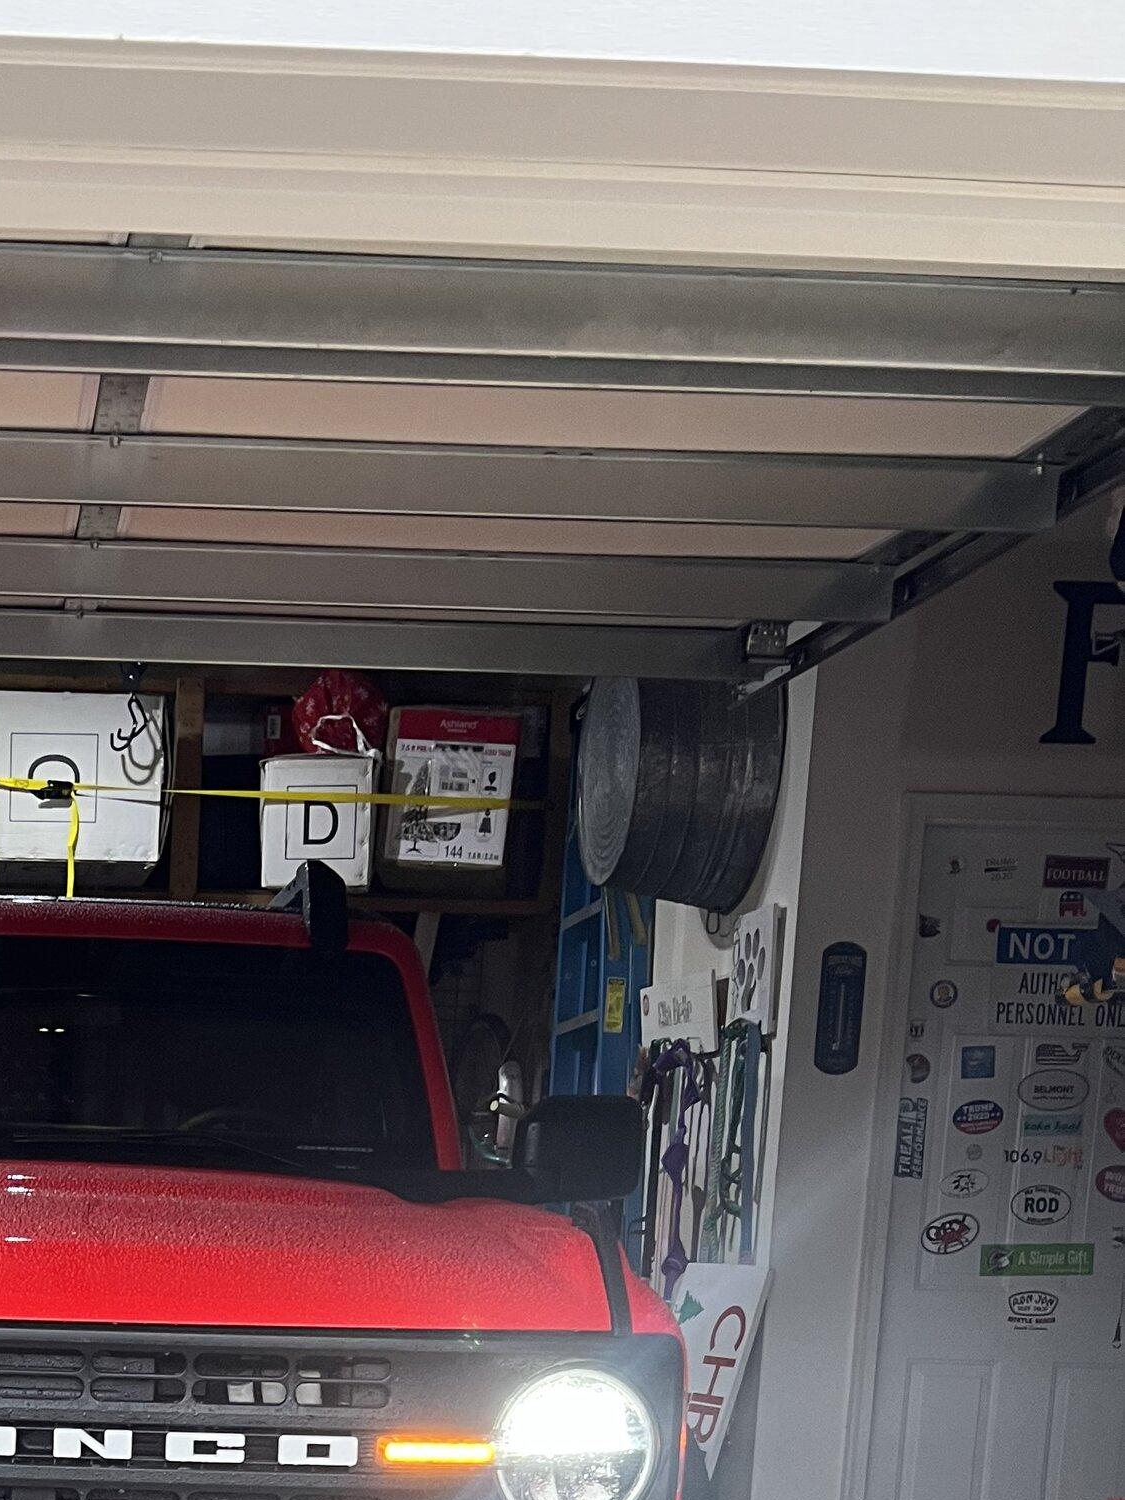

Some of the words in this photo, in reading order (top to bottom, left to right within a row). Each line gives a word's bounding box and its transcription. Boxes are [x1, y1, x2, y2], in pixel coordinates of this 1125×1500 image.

[303, 800, 339, 846] D
[444, 844, 463, 859] 144
[1046, 868, 1106, 882] FOOTBALL
[1008, 932, 1076, 961] NOT
[996, 1001, 1086, 1027] PERSONNEL
[1094, 1004, 1125, 1028] ONL
[1033, 1085, 1075, 1094] BELMONT
[962, 1103, 995, 1115] TRUMP
[911, 1098, 928, 1179] PERFORMANCE
[1003, 1148, 1043, 1164] 106.9
[1024, 1197, 1059, 1214] ROD
[1017, 1252, 1026, 1265] A
[1029, 1250, 1065, 1267] Simple
